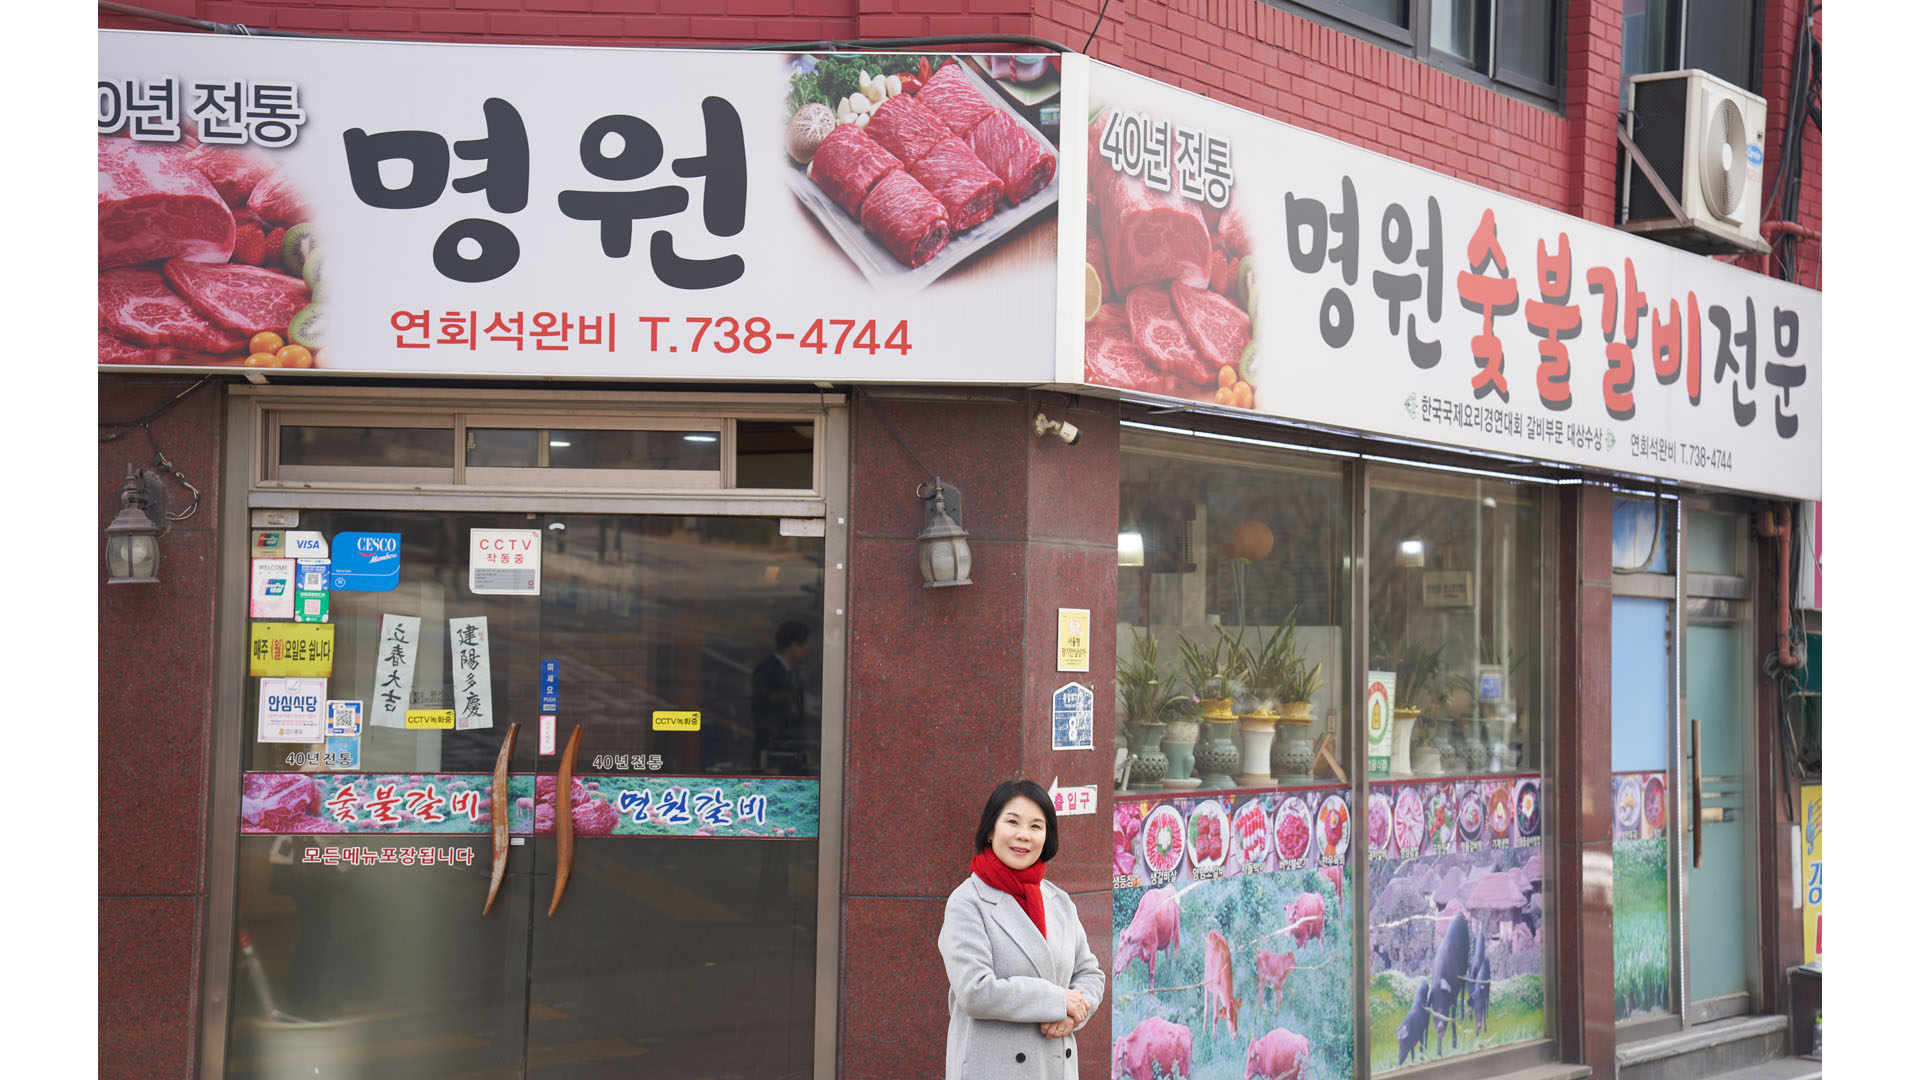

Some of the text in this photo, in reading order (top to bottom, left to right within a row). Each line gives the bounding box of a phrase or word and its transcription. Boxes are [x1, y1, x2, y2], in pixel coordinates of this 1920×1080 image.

[193, 81, 301, 142] 전통
[1103, 112, 1233, 202] 40년 전통
[343, 96, 748, 290] 명원
[389, 308, 913, 355] 연회석완비 T.738-4744
[1421, 396, 1603, 452] 한국국제요리경연대회 갈비부문 대상수상
[1630, 433, 1733, 471] 연회석완비 T.738-4744
[296, 539, 320, 549] VISA
[357, 537, 397, 552] CESCO
[479, 538, 532, 551] CCTV
[486, 553, 525, 564] 작동중
[253, 639, 331, 661] 매주 (월)요일은 쉽니다
[380, 623, 409, 712] 立春大吉
[456, 624, 484, 718] 建陽多慶
[268, 695, 317, 712] 안심식당
[326, 785, 480, 822] 숯불갈비
[620, 790, 767, 826] 명원갈비
[302, 847, 475, 865] 모든메뉴포장됩니다
